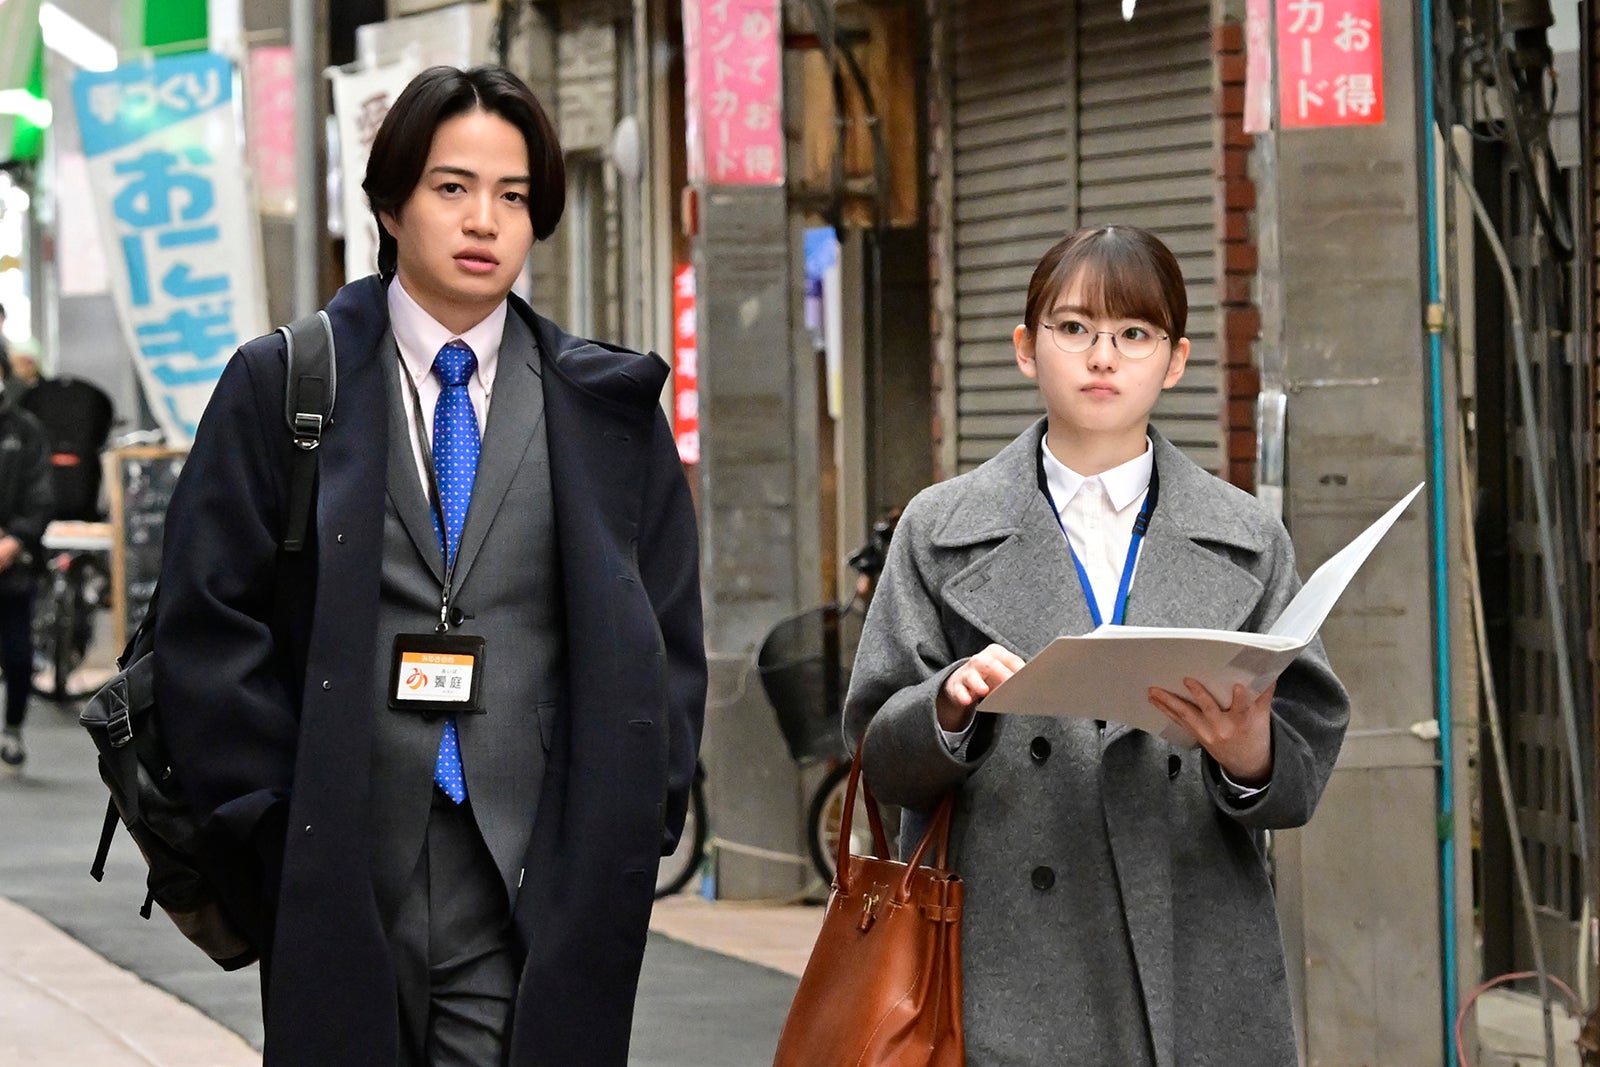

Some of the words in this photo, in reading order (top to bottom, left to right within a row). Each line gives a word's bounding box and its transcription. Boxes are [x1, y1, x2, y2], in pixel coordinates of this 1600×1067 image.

[1288, 0, 1328, 118] カード
[1333, 11, 1376, 117] お得
